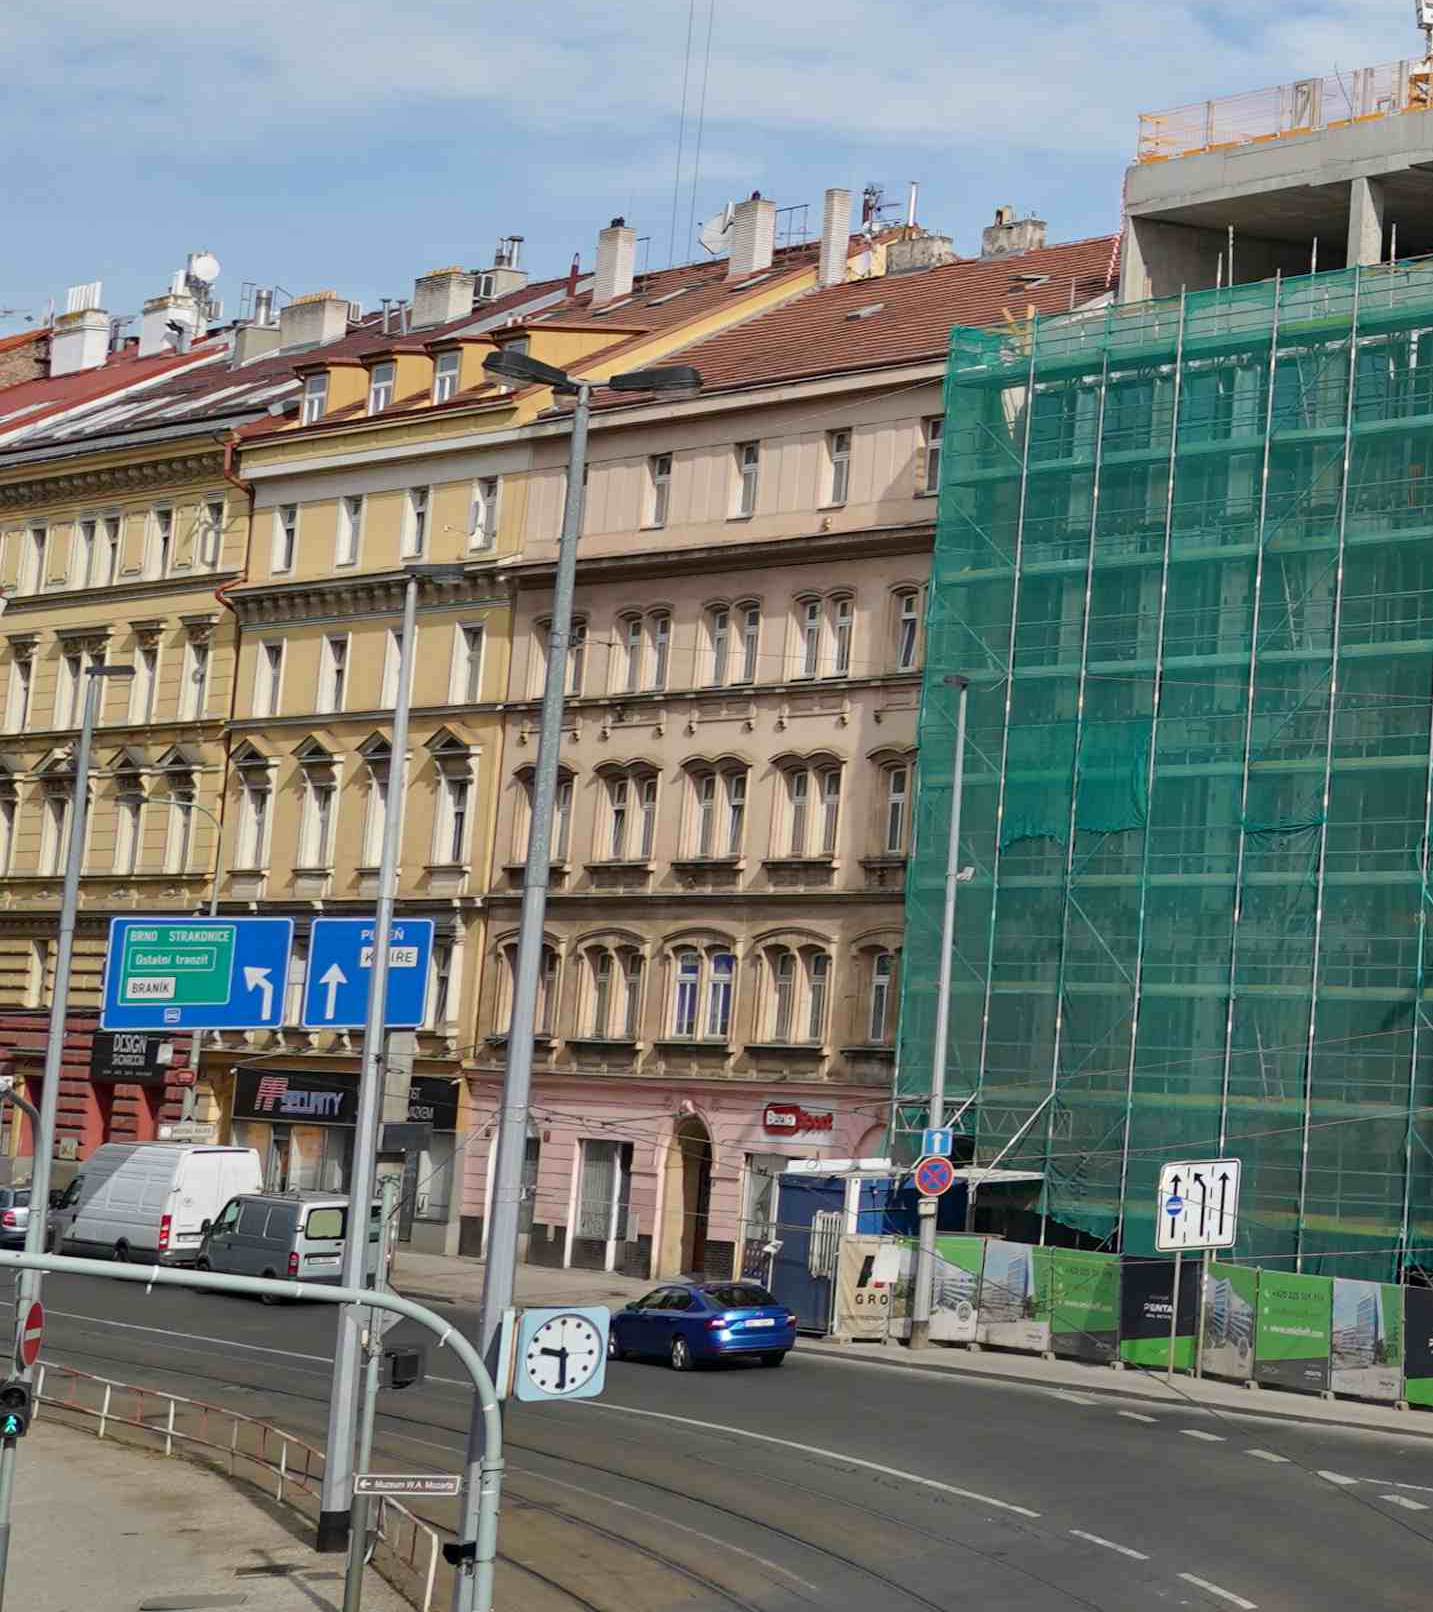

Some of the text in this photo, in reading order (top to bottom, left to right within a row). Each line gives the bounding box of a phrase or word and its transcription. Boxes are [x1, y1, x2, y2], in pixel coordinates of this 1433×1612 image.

[130, 930, 230, 942] BRNO STRAKONICE
[360, 926, 405, 941] PLEŇ
[176, 954, 208, 965] tranzit
[131, 981, 170, 994] BRANÍK
[112, 1034, 149, 1054] DESIGN
[282, 1090, 345, 1116] SECURITY
